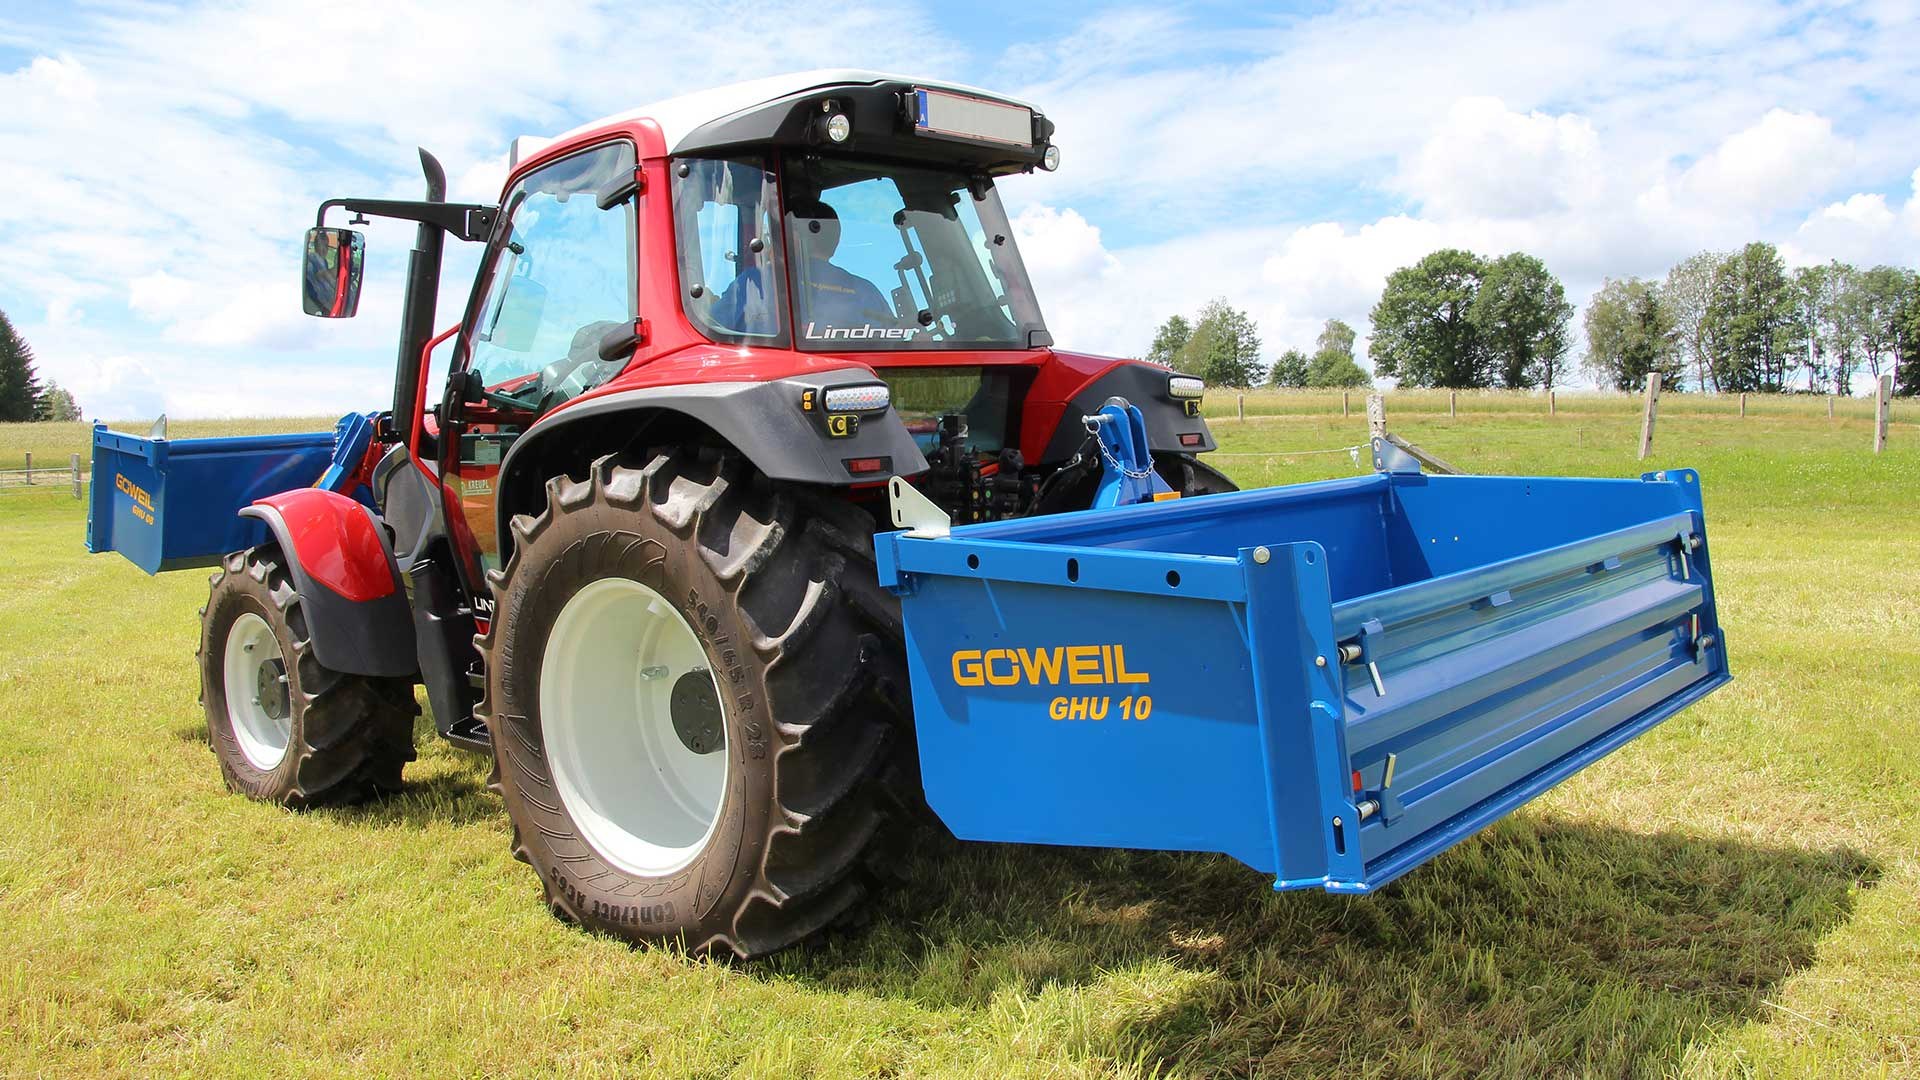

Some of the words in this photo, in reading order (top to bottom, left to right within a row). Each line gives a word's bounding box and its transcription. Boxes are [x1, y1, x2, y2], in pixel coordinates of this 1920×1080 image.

[805, 321, 920, 341] Lindner
[1049, 696, 1110, 721] GHU
[1118, 695, 1152, 721] 10
